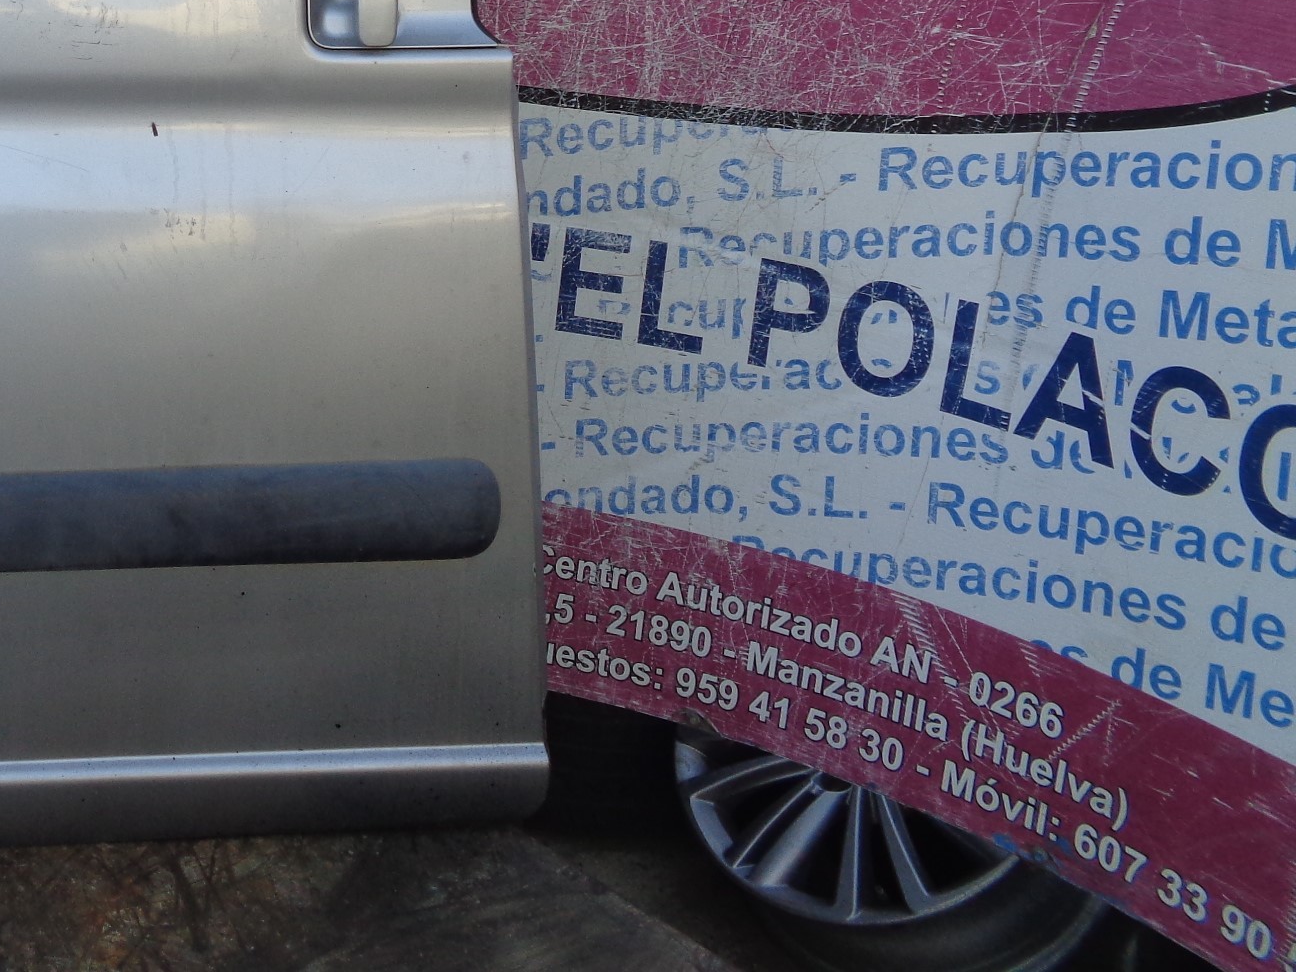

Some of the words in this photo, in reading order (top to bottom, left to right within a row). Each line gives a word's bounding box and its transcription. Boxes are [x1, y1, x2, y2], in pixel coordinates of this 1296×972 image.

[717, 155, 819, 204] S.L.
[678, 209, 1142, 270] Recuperaciones
[1163, 214, 1242, 268] de
[1065, 284, 1137, 336] de
[574, 412, 1010, 465] Recuperaciones
[768, 473, 868, 519] S.L.
[1209, 595, 1287, 652] de
[656, 571, 864, 659] Autorizado
[869, 636, 936, 686] AN
[968, 670, 1065, 740] 0266
[1110, 647, 1183, 701] de
[606, 603, 713, 660] 21890
[745, 640, 949, 743] Manzanilla
[960, 717, 1130, 832] (Huelva)
[674, 667, 740, 712] 959
[748, 690, 792, 730] 41
[803, 709, 850, 751] 58
[857, 727, 906, 773] 30
[939, 757, 1061, 843] Móvil:
[1073, 822, 1150, 885] 607
[1156, 867, 1209, 924] 33
[1219, 903, 1274, 961] 90
